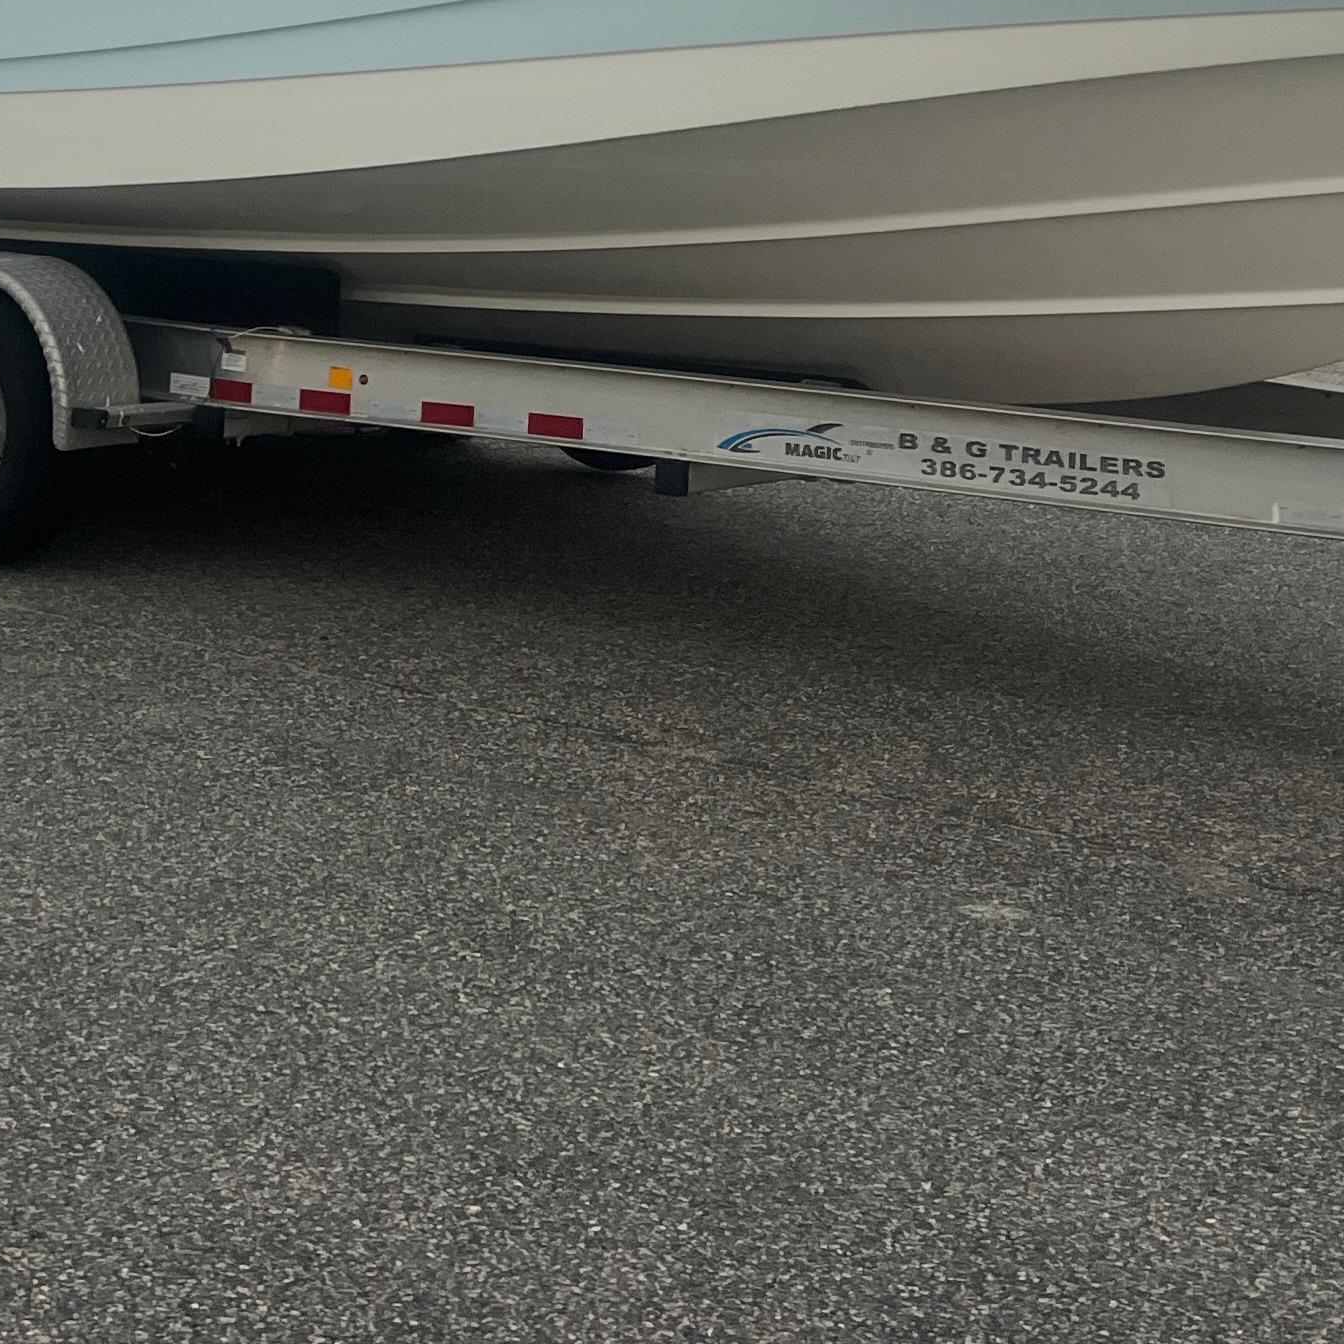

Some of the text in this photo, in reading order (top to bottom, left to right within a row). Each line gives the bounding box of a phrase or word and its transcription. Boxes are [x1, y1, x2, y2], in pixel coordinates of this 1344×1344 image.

[785, 442, 843, 461] MAGIC
[898, 433, 918, 450] B
[931, 437, 952, 454] &
[965, 441, 987, 457] G
[999, 444, 1166, 478] TRAILERS
[920, 458, 1140, 500] 386-734-5244
